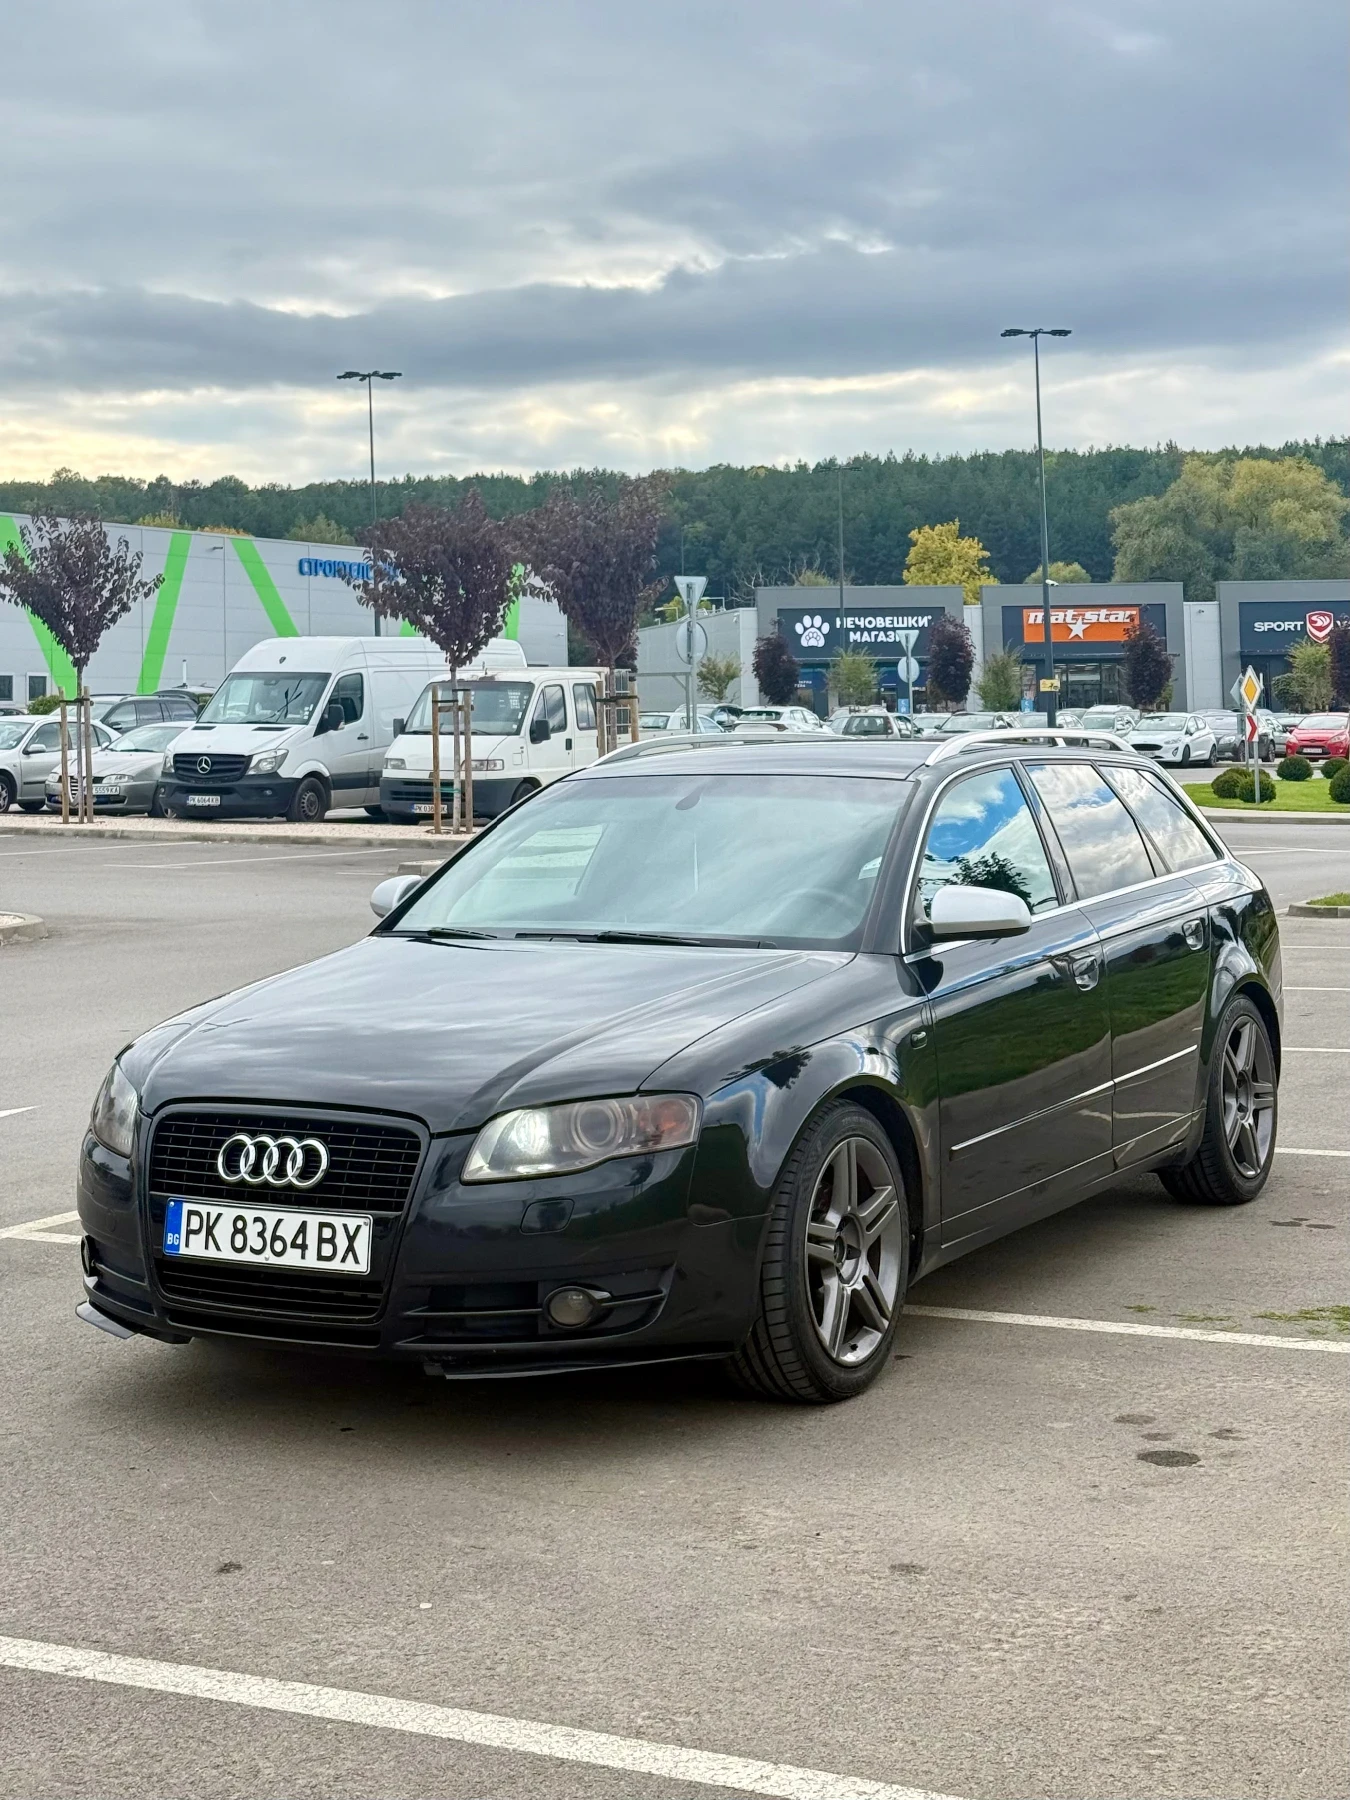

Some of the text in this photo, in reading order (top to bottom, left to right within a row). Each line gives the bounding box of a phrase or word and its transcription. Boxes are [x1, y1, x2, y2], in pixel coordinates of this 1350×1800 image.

[1254, 621, 1304, 632] SPORT
[849, 631, 902, 642] МАГАЗ
[167, 1232, 180, 1246] BG
[185, 1209, 363, 1265] PK 8364 BX
